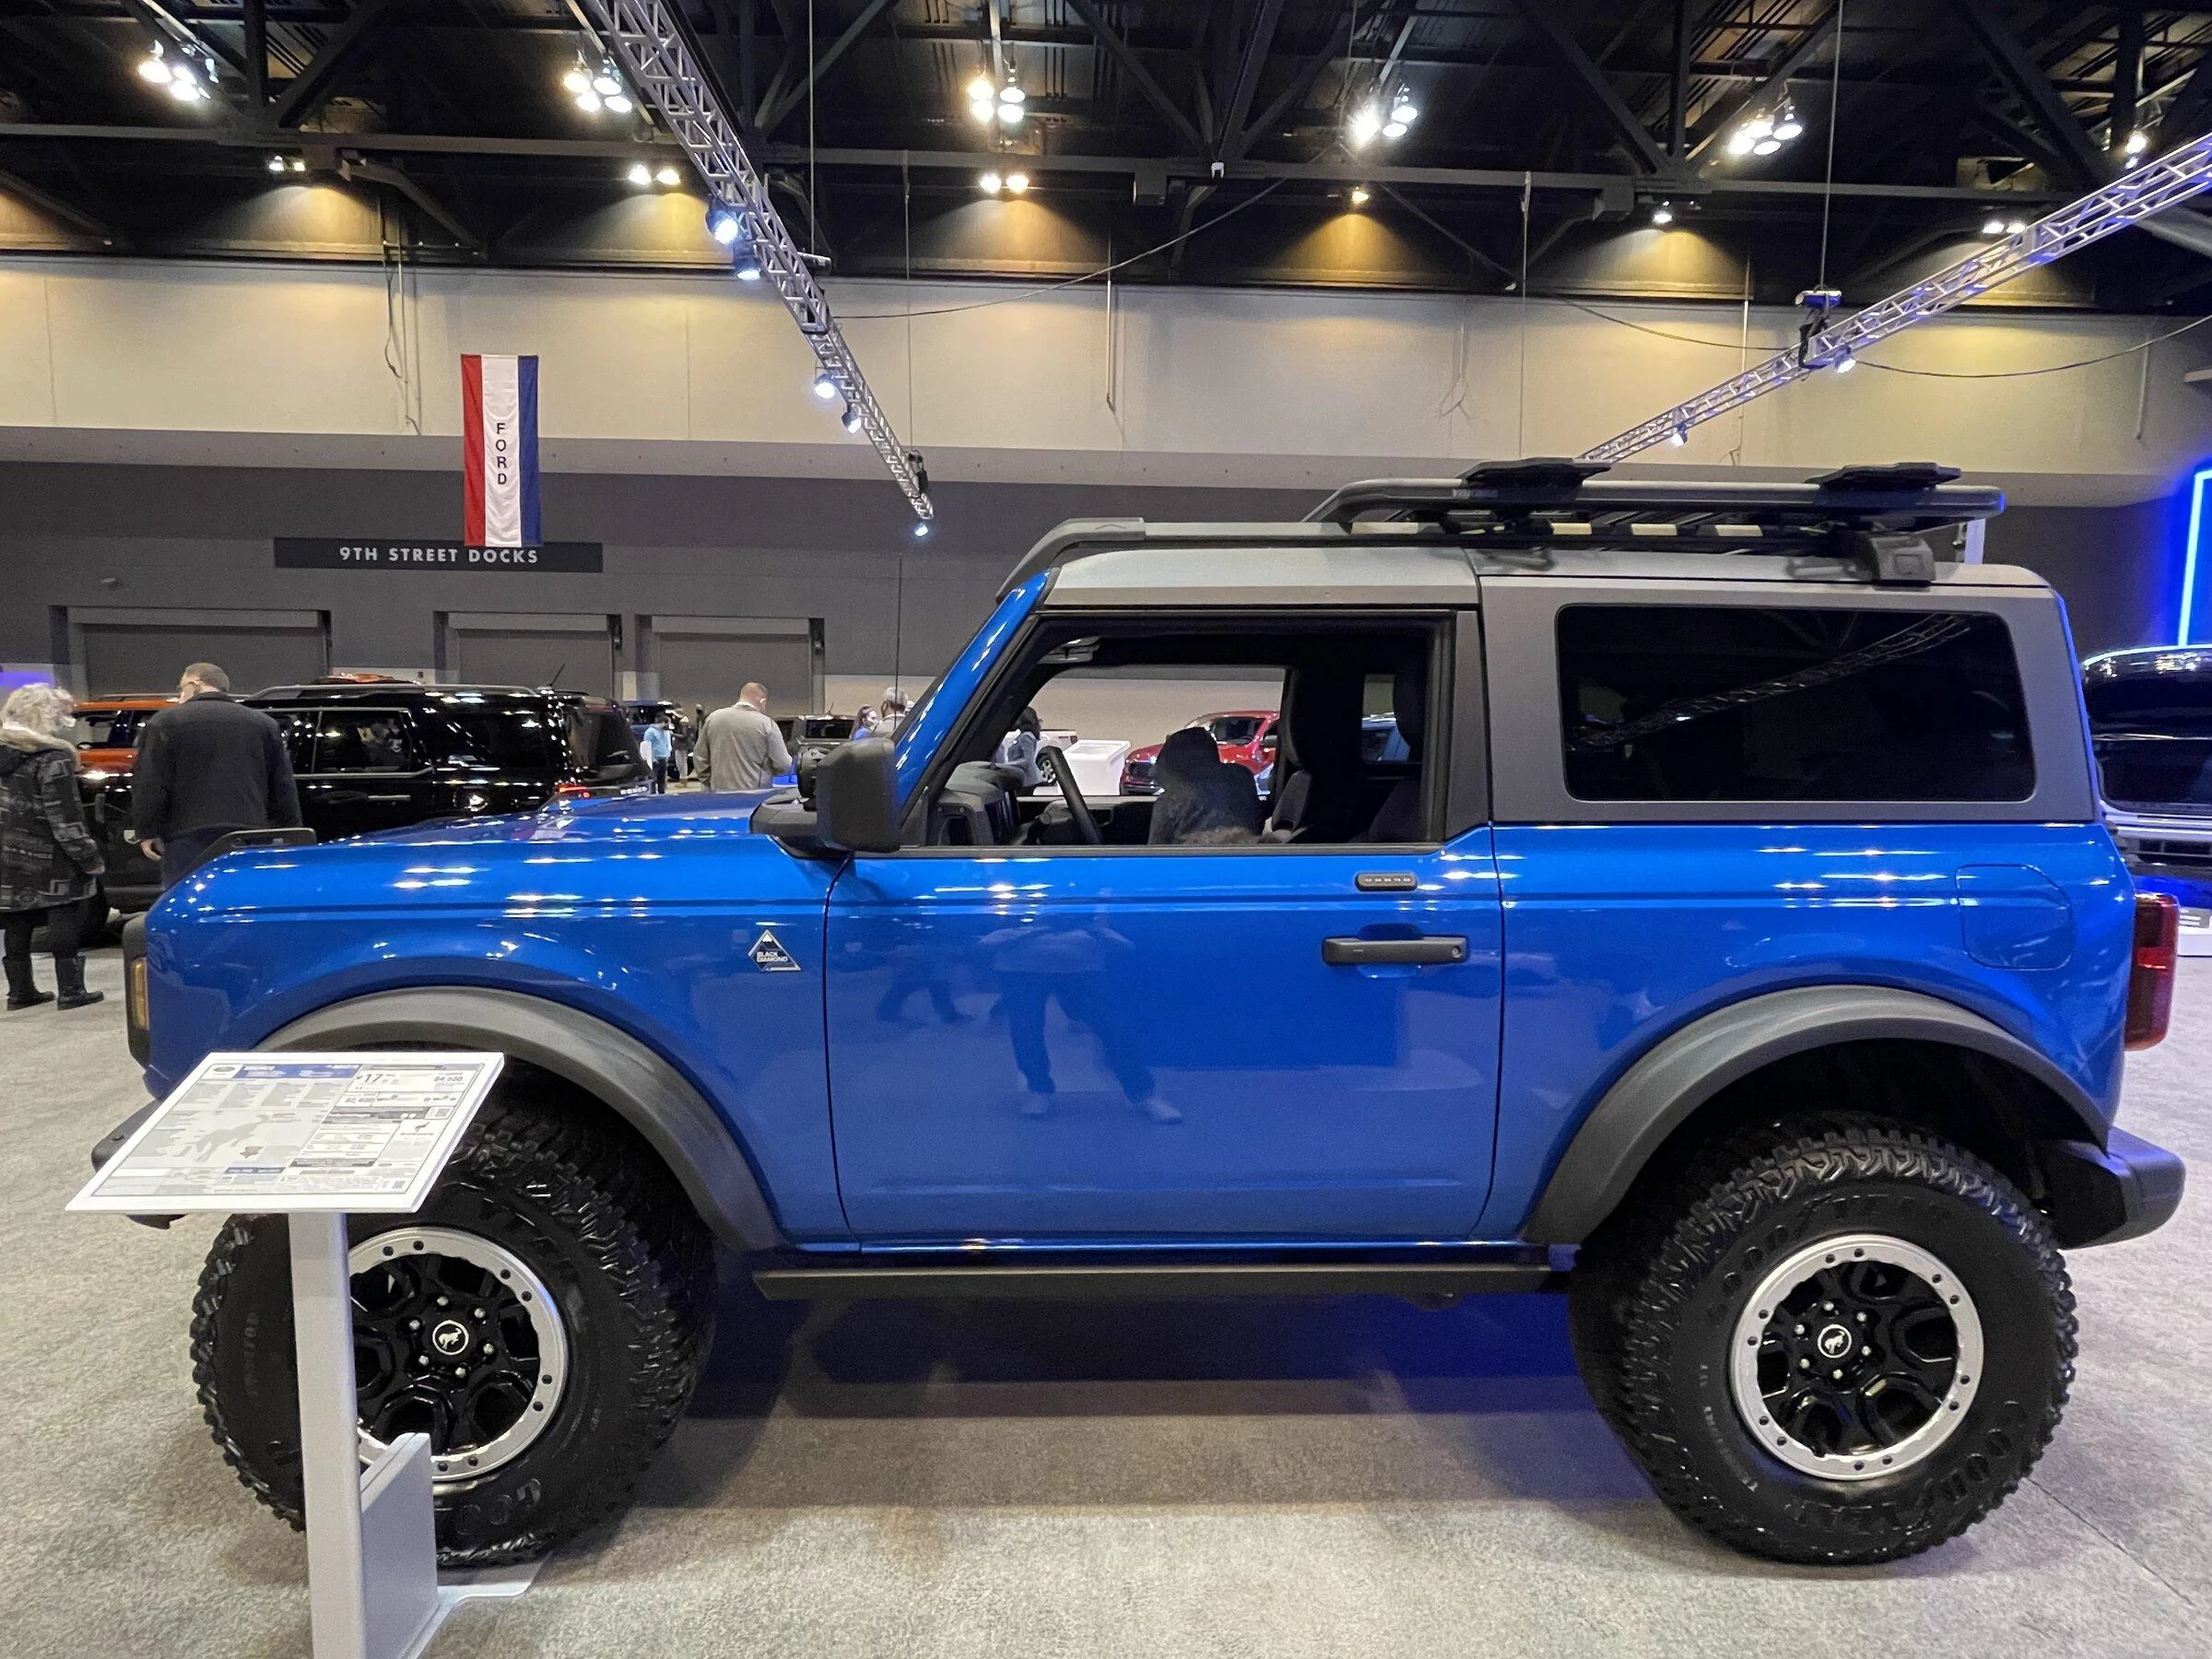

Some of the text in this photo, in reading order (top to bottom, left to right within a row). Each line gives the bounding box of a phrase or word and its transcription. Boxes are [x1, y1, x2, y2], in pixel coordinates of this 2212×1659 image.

[495, 422, 508, 486] FORD
[338, 547, 538, 563] 9TH STREET DOCKS
